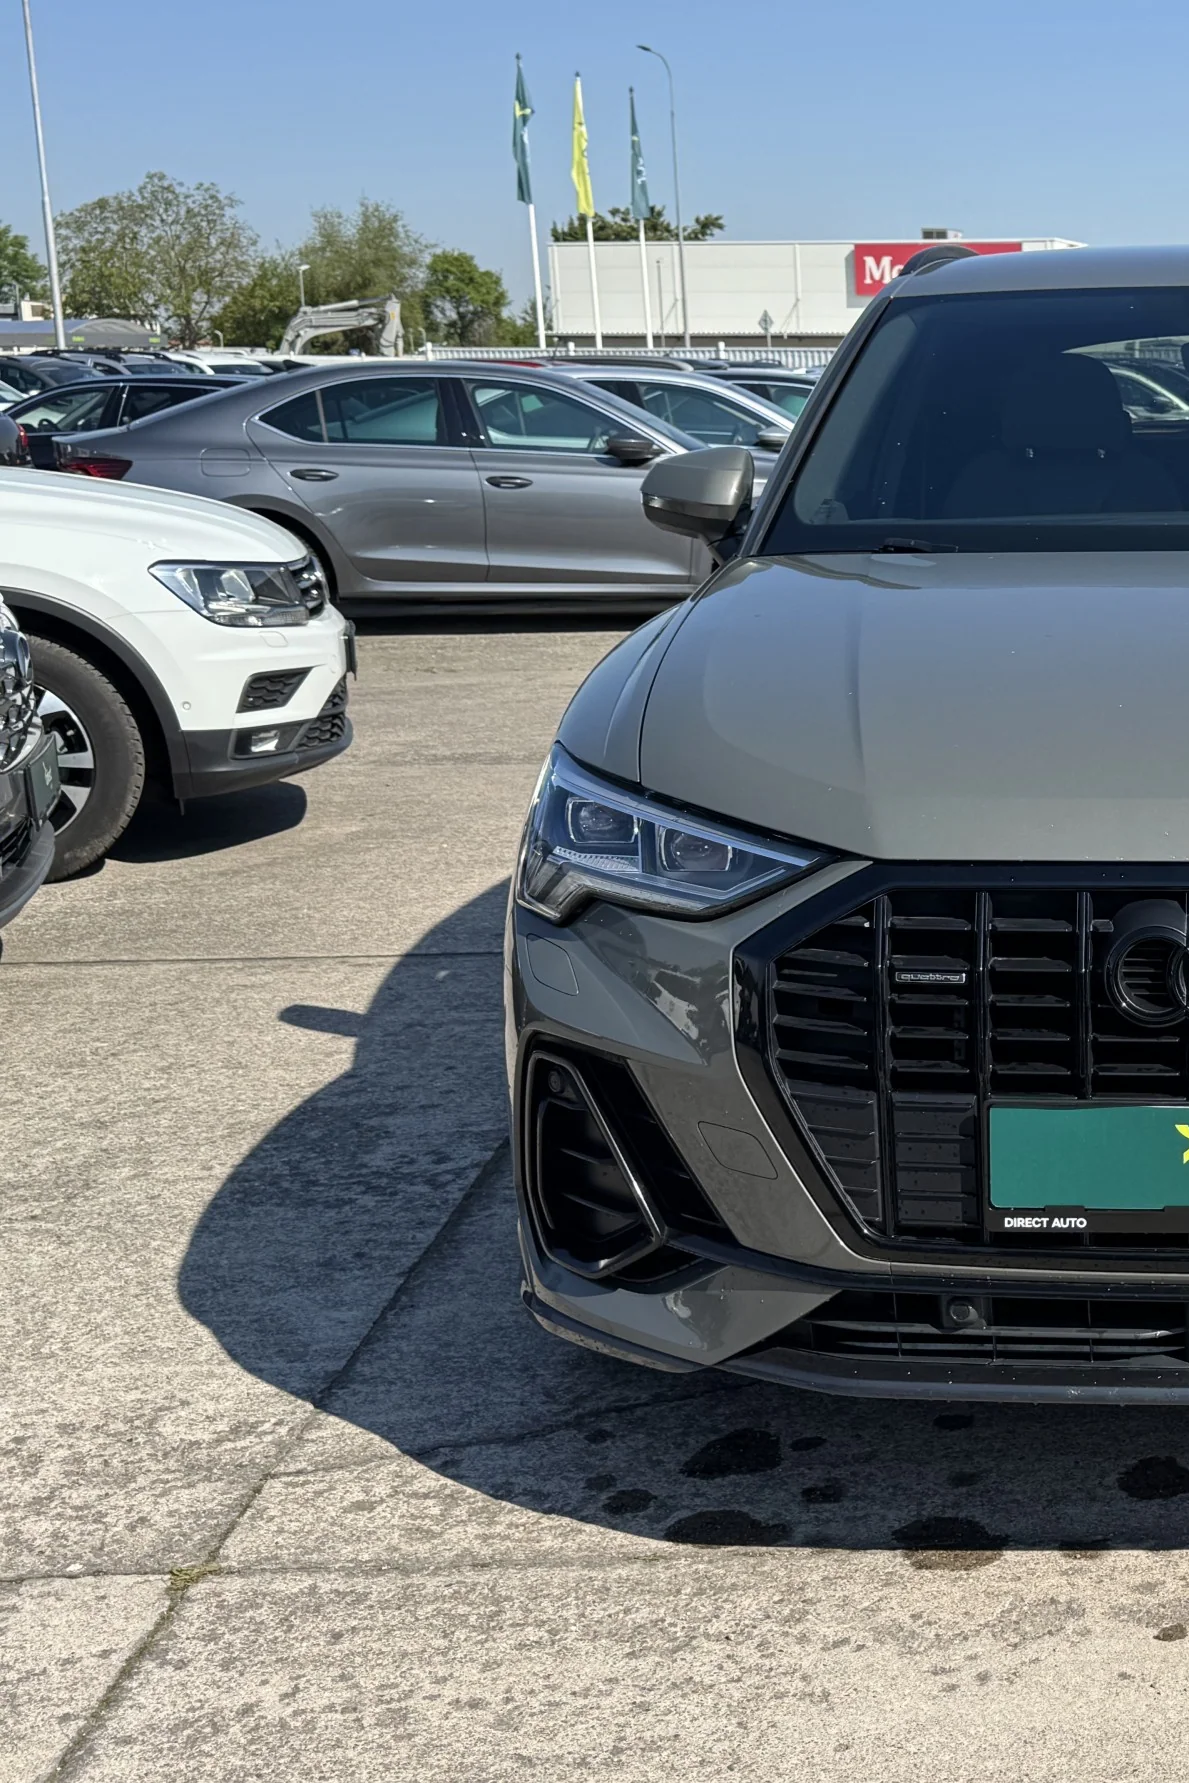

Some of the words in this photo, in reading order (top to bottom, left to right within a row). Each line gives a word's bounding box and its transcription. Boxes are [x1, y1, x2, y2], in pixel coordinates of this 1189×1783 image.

[900, 973, 960, 981] quattro
[1004, 1217, 1049, 1228] DIRECT
[1051, 1217, 1087, 1228] AUTO
